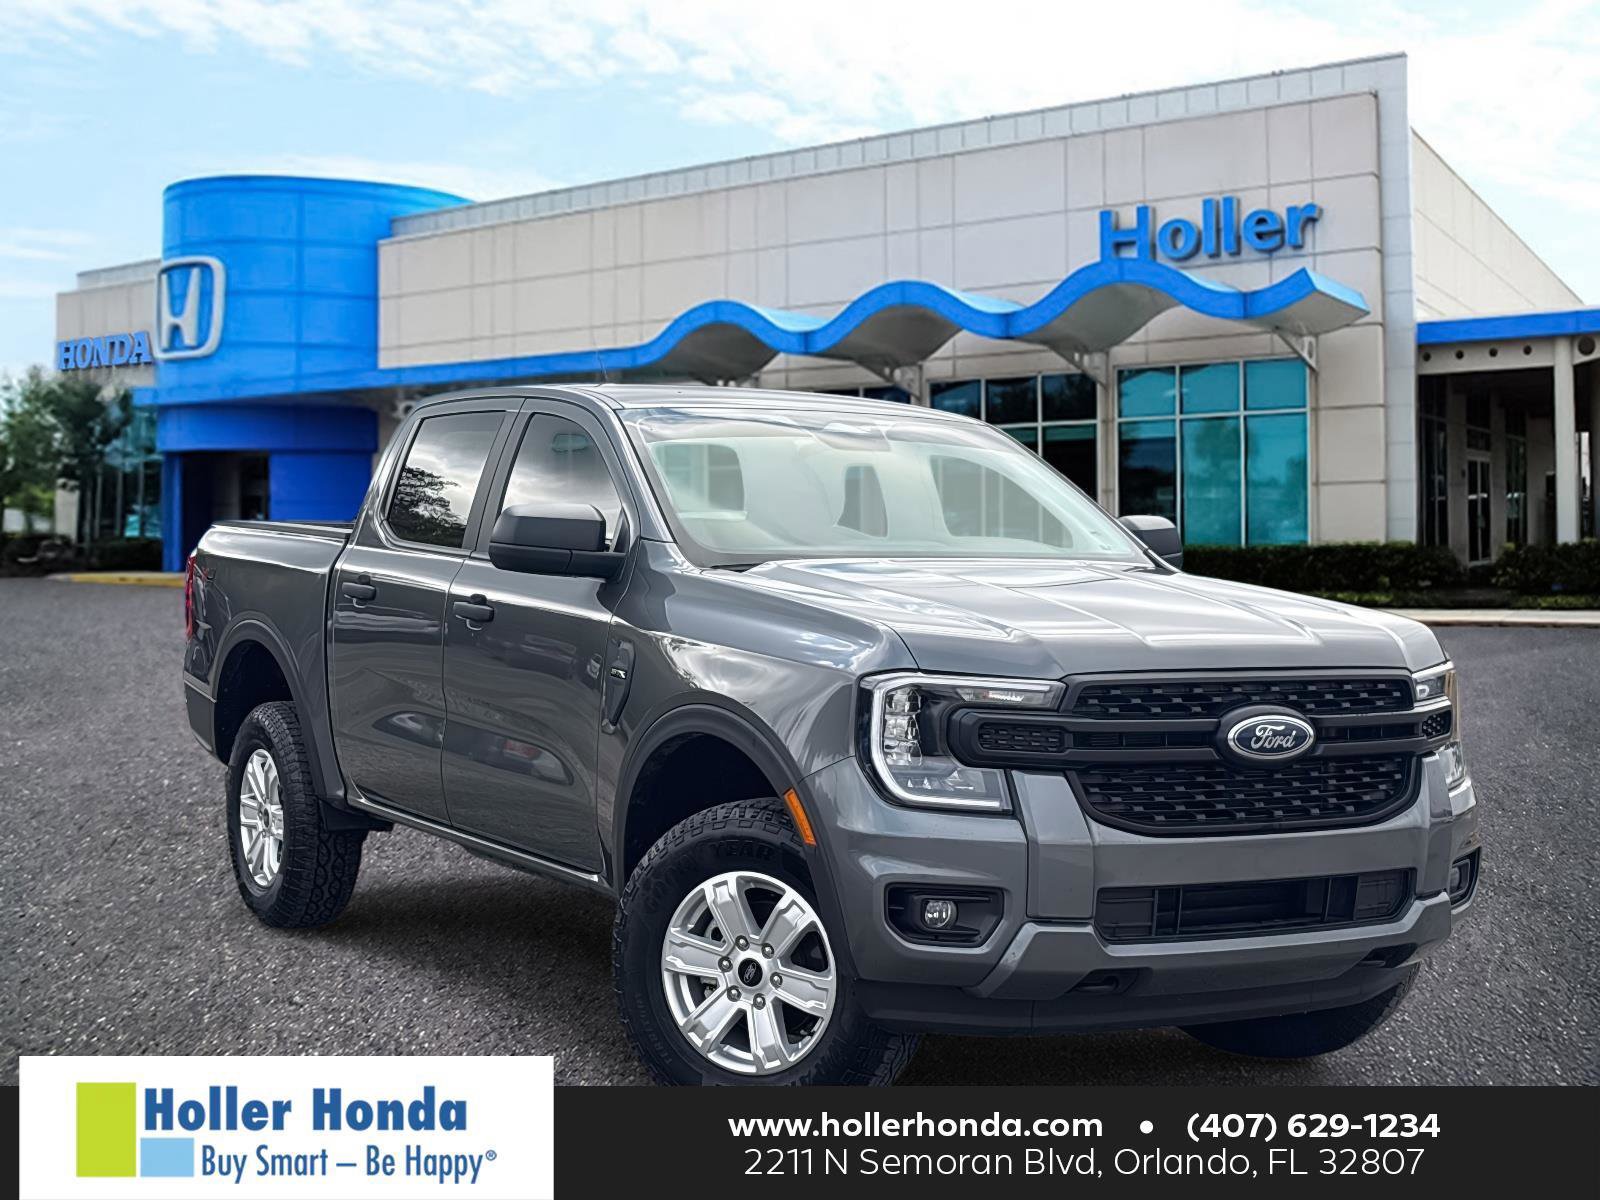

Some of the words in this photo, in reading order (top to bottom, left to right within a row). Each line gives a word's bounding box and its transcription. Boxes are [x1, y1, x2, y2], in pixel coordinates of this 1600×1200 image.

[1099, 195, 1322, 262] Holler
[57, 331, 152, 371] HONDA
[1251, 724, 1297, 749] Ford
